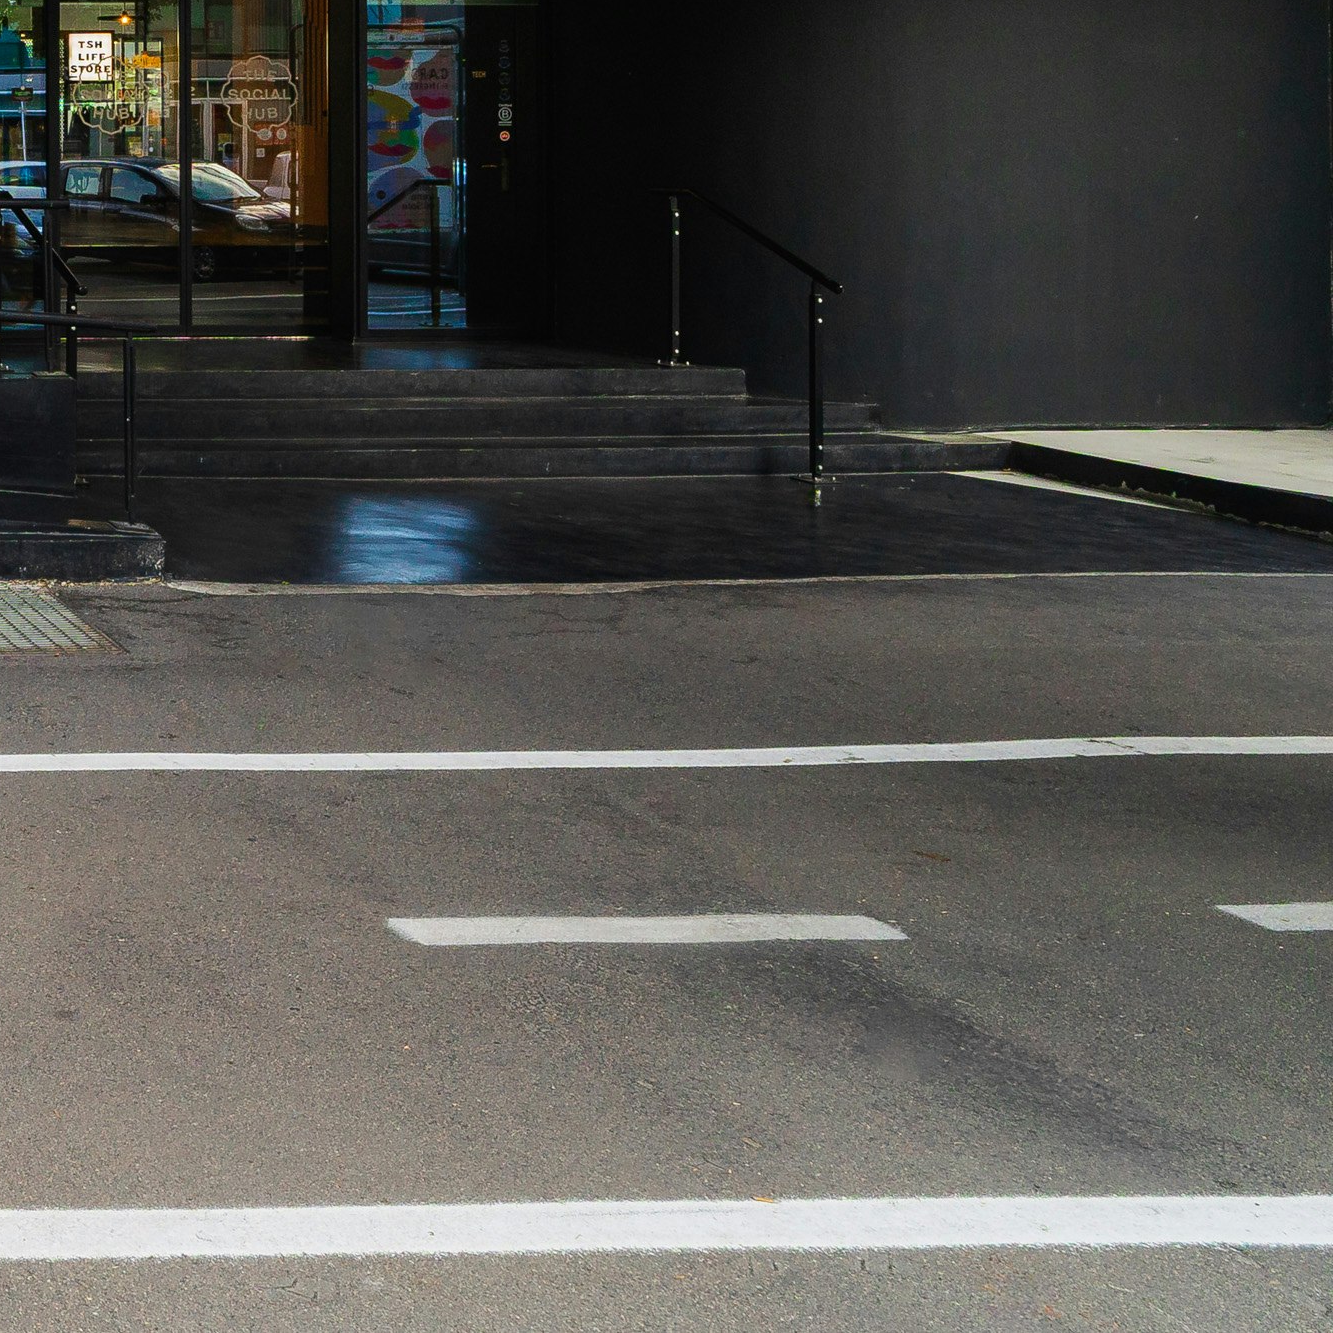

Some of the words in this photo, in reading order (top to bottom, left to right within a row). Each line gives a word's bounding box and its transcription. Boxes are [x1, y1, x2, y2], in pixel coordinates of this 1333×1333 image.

[77, 40, 103, 49] TSH
[78, 53, 106, 61] LIFE
[70, 65, 111, 74] STORE
[228, 88, 291, 100] SOCIAL
[93, 106, 129, 121] HUB
